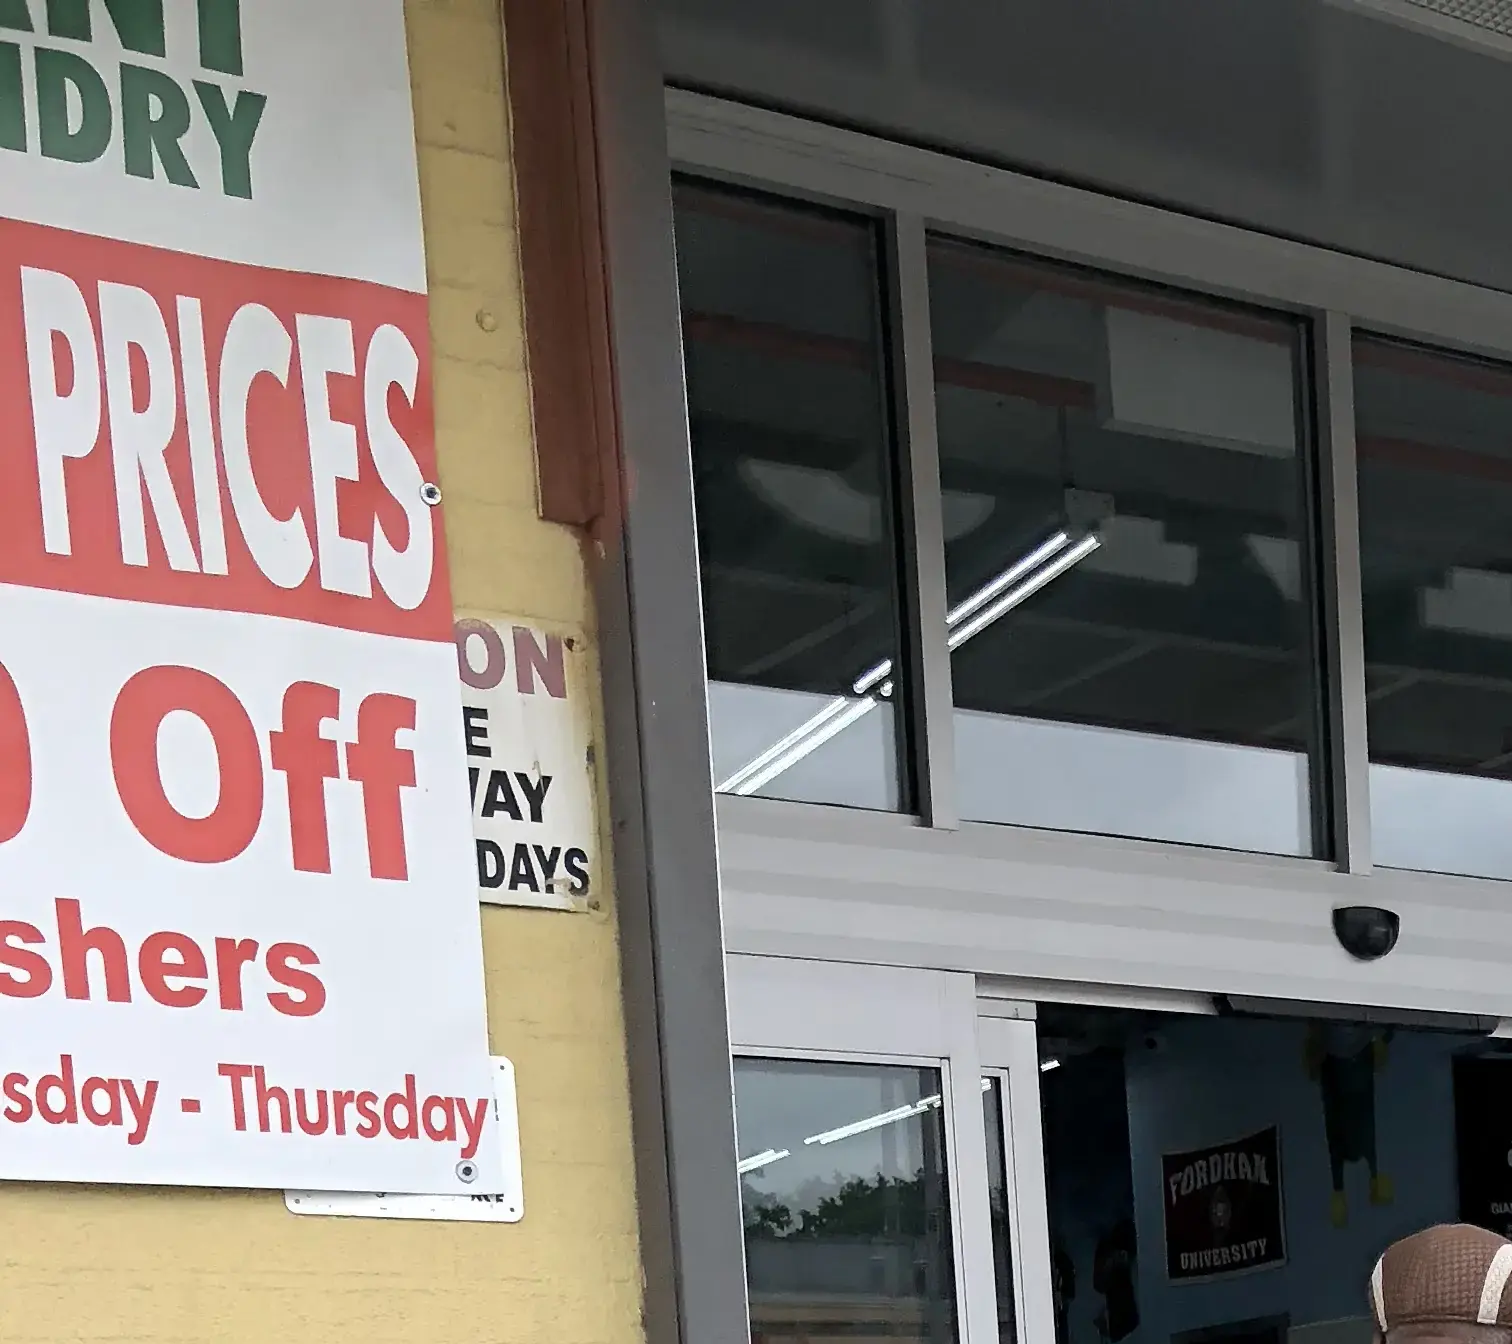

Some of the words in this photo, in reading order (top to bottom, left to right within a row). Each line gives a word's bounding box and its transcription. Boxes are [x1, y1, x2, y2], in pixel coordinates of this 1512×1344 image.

[0, 42, 267, 199] DRY
[20, 265, 434, 610] PRICES
[110, 664, 417, 881] Off
[4, 1054, 159, 1146] sday
[218, 1063, 488, 1159] Thursday
[1169, 1151, 1271, 1208] FORDHAM
[1180, 1238, 1268, 1270] UNIVERSITY
